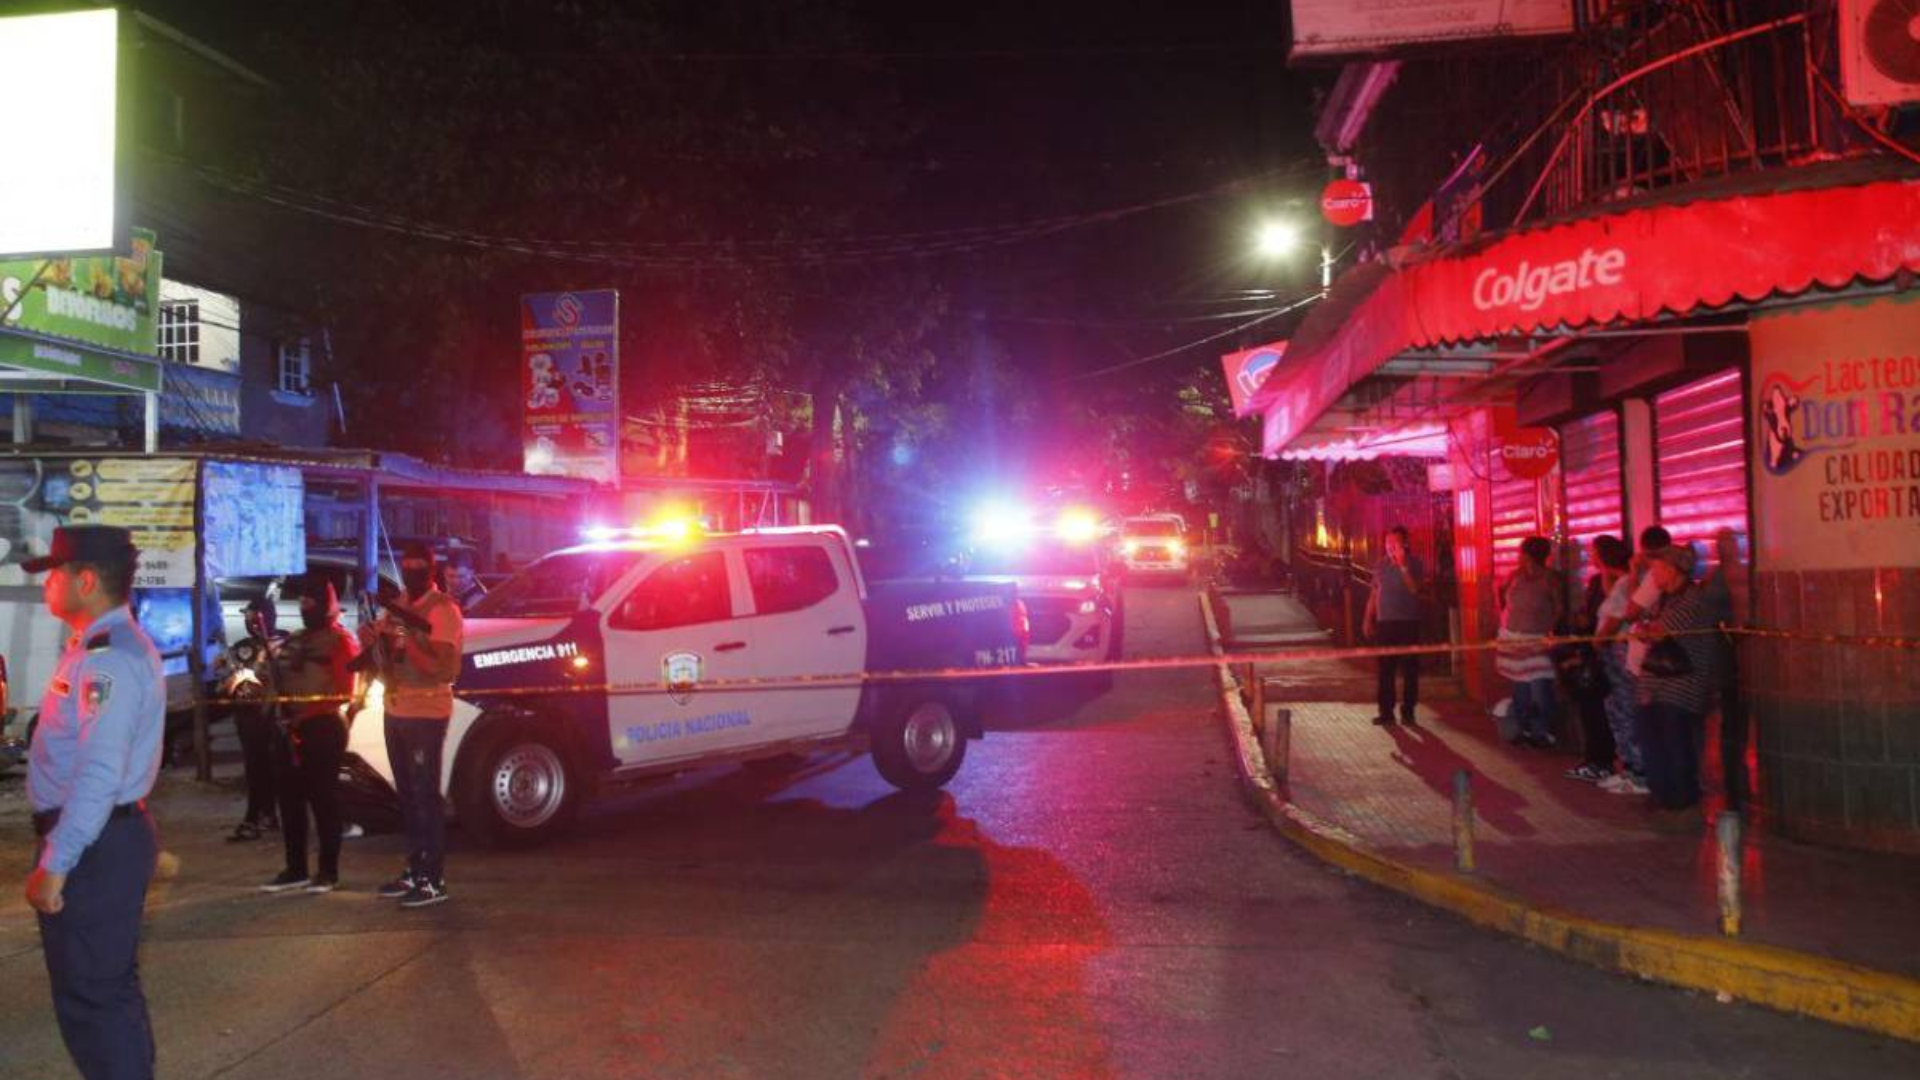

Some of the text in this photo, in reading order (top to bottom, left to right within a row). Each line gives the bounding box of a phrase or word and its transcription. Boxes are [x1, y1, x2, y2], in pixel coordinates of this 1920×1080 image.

[1322, 192, 1361, 210] Claro
[1473, 248, 1625, 311] Colgate
[1503, 444, 1547, 459] Claro
[1824, 449, 1920, 485] CALIDAD
[1818, 485, 1920, 523] EXPORTA
[906, 602, 944, 621] SERVIR
[945, 602, 954, 615] Y
[473, 641, 579, 670] EMERGENCIA 911
[626, 709, 751, 743] POLICIA NACIONAL
